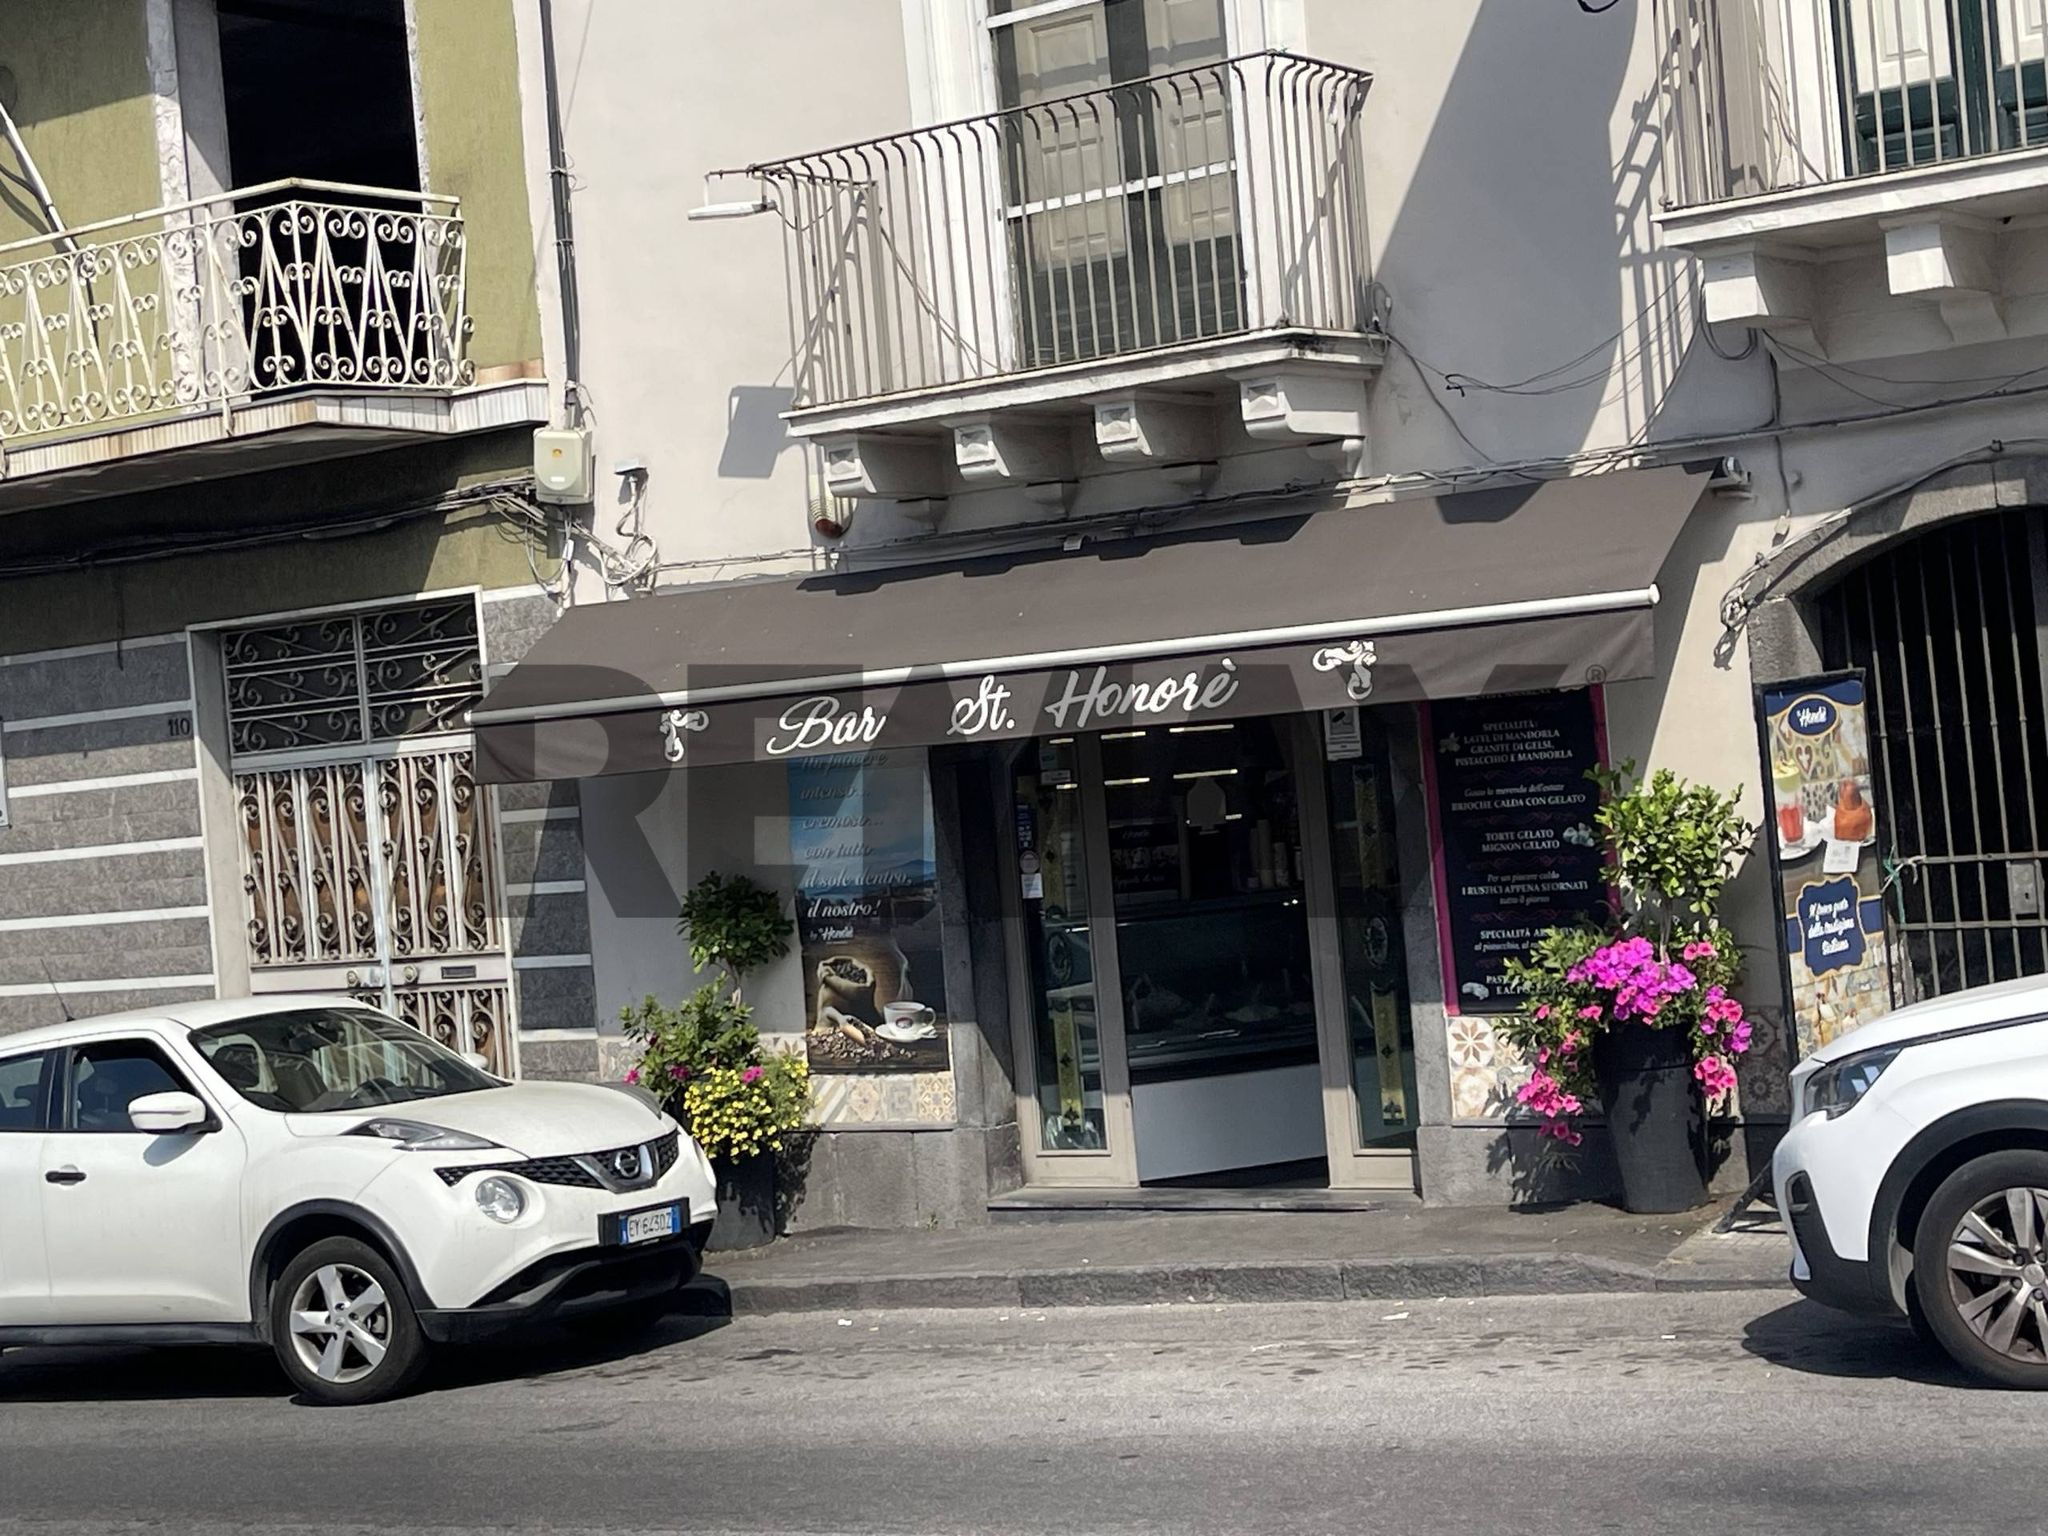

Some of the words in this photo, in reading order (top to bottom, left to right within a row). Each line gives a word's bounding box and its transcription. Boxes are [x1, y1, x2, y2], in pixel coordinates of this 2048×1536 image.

[766, 695, 887, 754] Bar
[946, 674, 1015, 735] St.
[1044, 657, 1239, 728] Honorè
[168, 717, 190, 736] 110
[1492, 733, 1503, 742] DI
[1504, 729, 1560, 741] MANDORLA
[1470, 743, 1511, 755] GRANITE
[1513, 742, 1524, 751] DI
[1455, 754, 1509, 767] PISTACCHIO
[1517, 749, 1573, 762] MANDORLA
[1451, 801, 1493, 812] BRIOCHE
[1494, 798, 1524, 809] CALDA
[1525, 796, 1547, 807] CON
[1548, 793, 1586, 805] GELATO
[1485, 831, 1516, 842] TORTE
[1517, 829, 1554, 840] GELATO
[1482, 841, 1521, 853] MIGNON
[1522, 839, 1560, 850] GELATO
[804, 867, 819, 888] il
[820, 865, 851, 888] sole
[854, 865, 913, 887] dentro,
[1467, 884, 1503, 896] RUSTICI
[1504, 883, 1540, 894] APPENA
[1541, 880, 1588, 892] SFORNATI
[807, 898, 822, 918] il
[821, 899, 882, 917] nostro!
[1480, 927, 1531, 939] SPECIALITÀ
